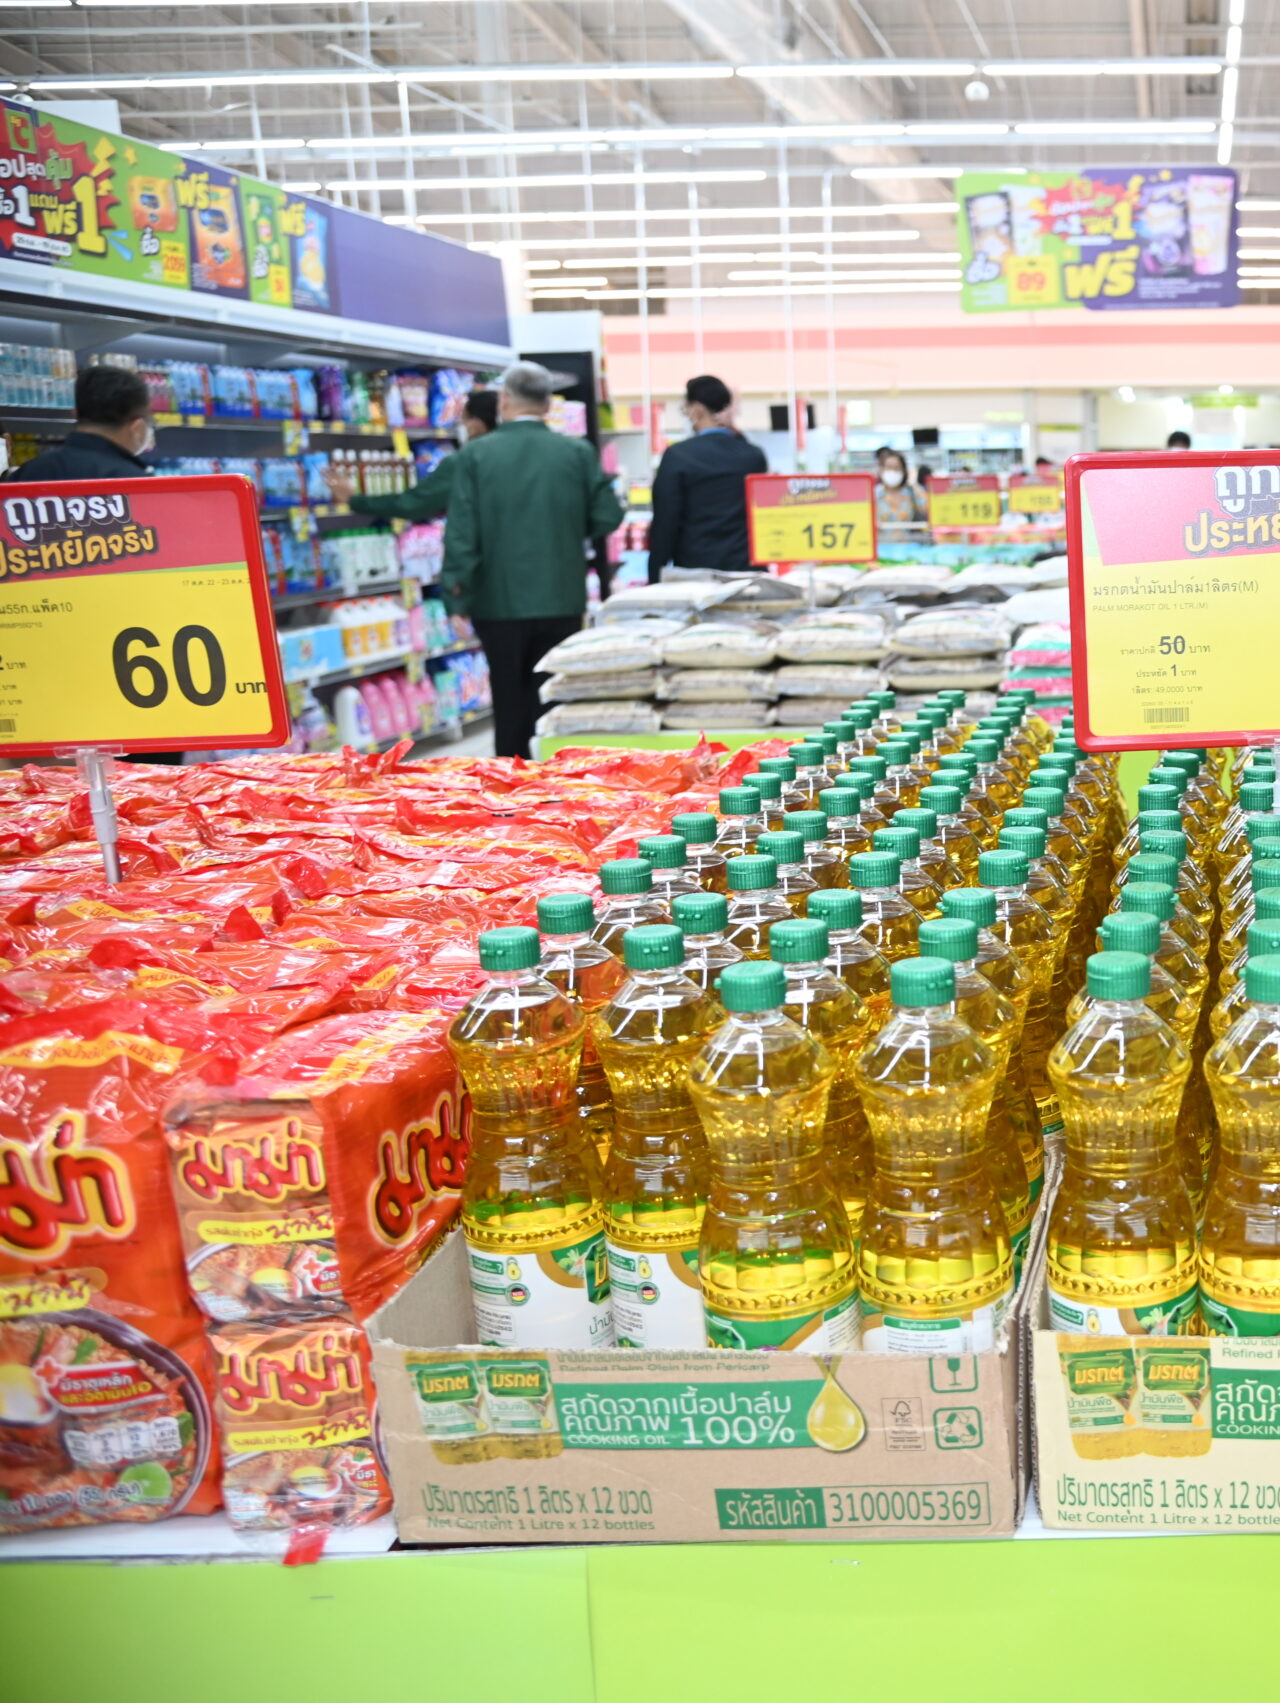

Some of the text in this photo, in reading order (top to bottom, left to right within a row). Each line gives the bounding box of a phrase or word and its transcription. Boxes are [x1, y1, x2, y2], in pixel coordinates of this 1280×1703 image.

[802, 523, 856, 549] 157
[1159, 635, 1186, 655] 50
[112, 624, 226, 709] 60
[1170, 664, 1177, 677] 1
[180, 1117, 324, 1202] มาม่า
[589, 1311, 614, 1335] น้ำมั
[1222, 1348, 1273, 1359] Refined
[220, 1333, 361, 1414] มาม่า
[716, 1362, 771, 1373] Pericarp
[1074, 1365, 1124, 1385] มรกต
[1148, 1364, 1201, 1381] มรกต
[423, 1375, 469, 1394] มรกต
[492, 1373, 541, 1389] มรกต
[561, 1385, 793, 1415] สกัดจากเนื้อปาล์ม
[564, 1414, 796, 1446] คุณภาพ 100%
[567, 1434, 671, 1446] COOKING OIL
[523, 1486, 536, 1514] 1
[576, 1491, 590, 1513] x
[591, 1486, 615, 1514] 12
[618, 1489, 654, 1514] ขวด
[1056, 1473, 1155, 1515] ปริมาตรสุทธิ
[1160, 1480, 1170, 1508] 1
[1175, 1479, 1209, 1508] ลิตร
[1214, 1487, 1224, 1508] x
[1229, 1480, 1250, 1509] 12
[725, 1488, 982, 1526] รหัสสินค้า 3100005369
[1057, 1509, 1083, 1522] Net
[1086, 1510, 1145, 1524] Content
[1150, 1512, 1158, 1524] 1
[1163, 1512, 1197, 1525] Litre
[1201, 1516, 1209, 1524] x
[1215, 1513, 1232, 1525] 12
[427, 1516, 656, 1531] Net Content 1 Litre x 12 bottles
